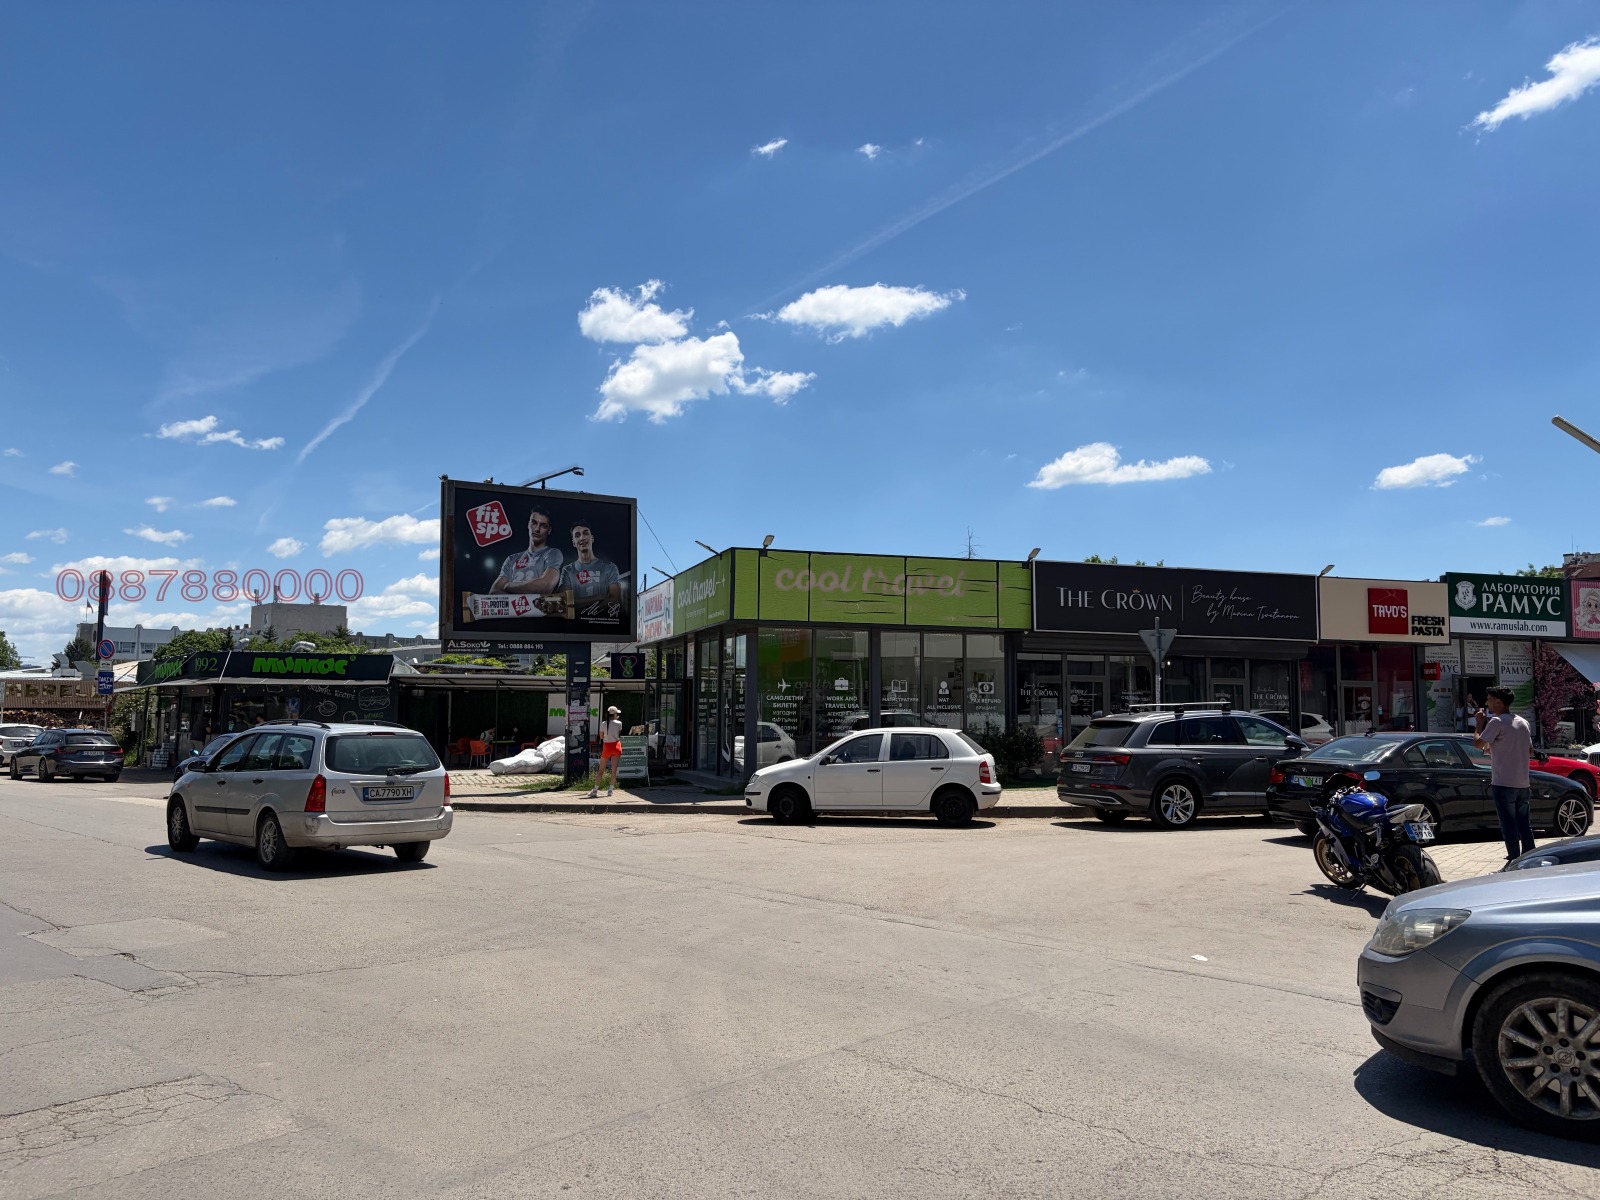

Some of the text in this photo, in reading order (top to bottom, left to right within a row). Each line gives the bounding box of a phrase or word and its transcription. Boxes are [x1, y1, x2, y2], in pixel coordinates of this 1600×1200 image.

[476, 505, 499, 523] fit
[476, 522, 511, 538] spo
[775, 566, 966, 597] cool travel
[1191, 585, 1252, 607] Beauty house
[1482, 582, 1560, 596] ЛАБОРАТОРИЯ
[1055, 586, 1172, 612] THE CROWN
[1482, 593, 1561, 616] РАМУС
[1207, 603, 1219, 623] by
[1222, 605, 1256, 619] Marina
[1411, 616, 1445, 626] FRESH
[1470, 620, 1548, 633] www.ramuslab.com
[1411, 626, 1445, 636] PASTA
[194, 657, 218, 672] 1992
[1501, 666, 1532, 675] РАМУС
[1020, 688, 1059, 697] THE CROWN
[1253, 692, 1263, 700] THE
[370, 788, 412, 798] CA 7790 XH
